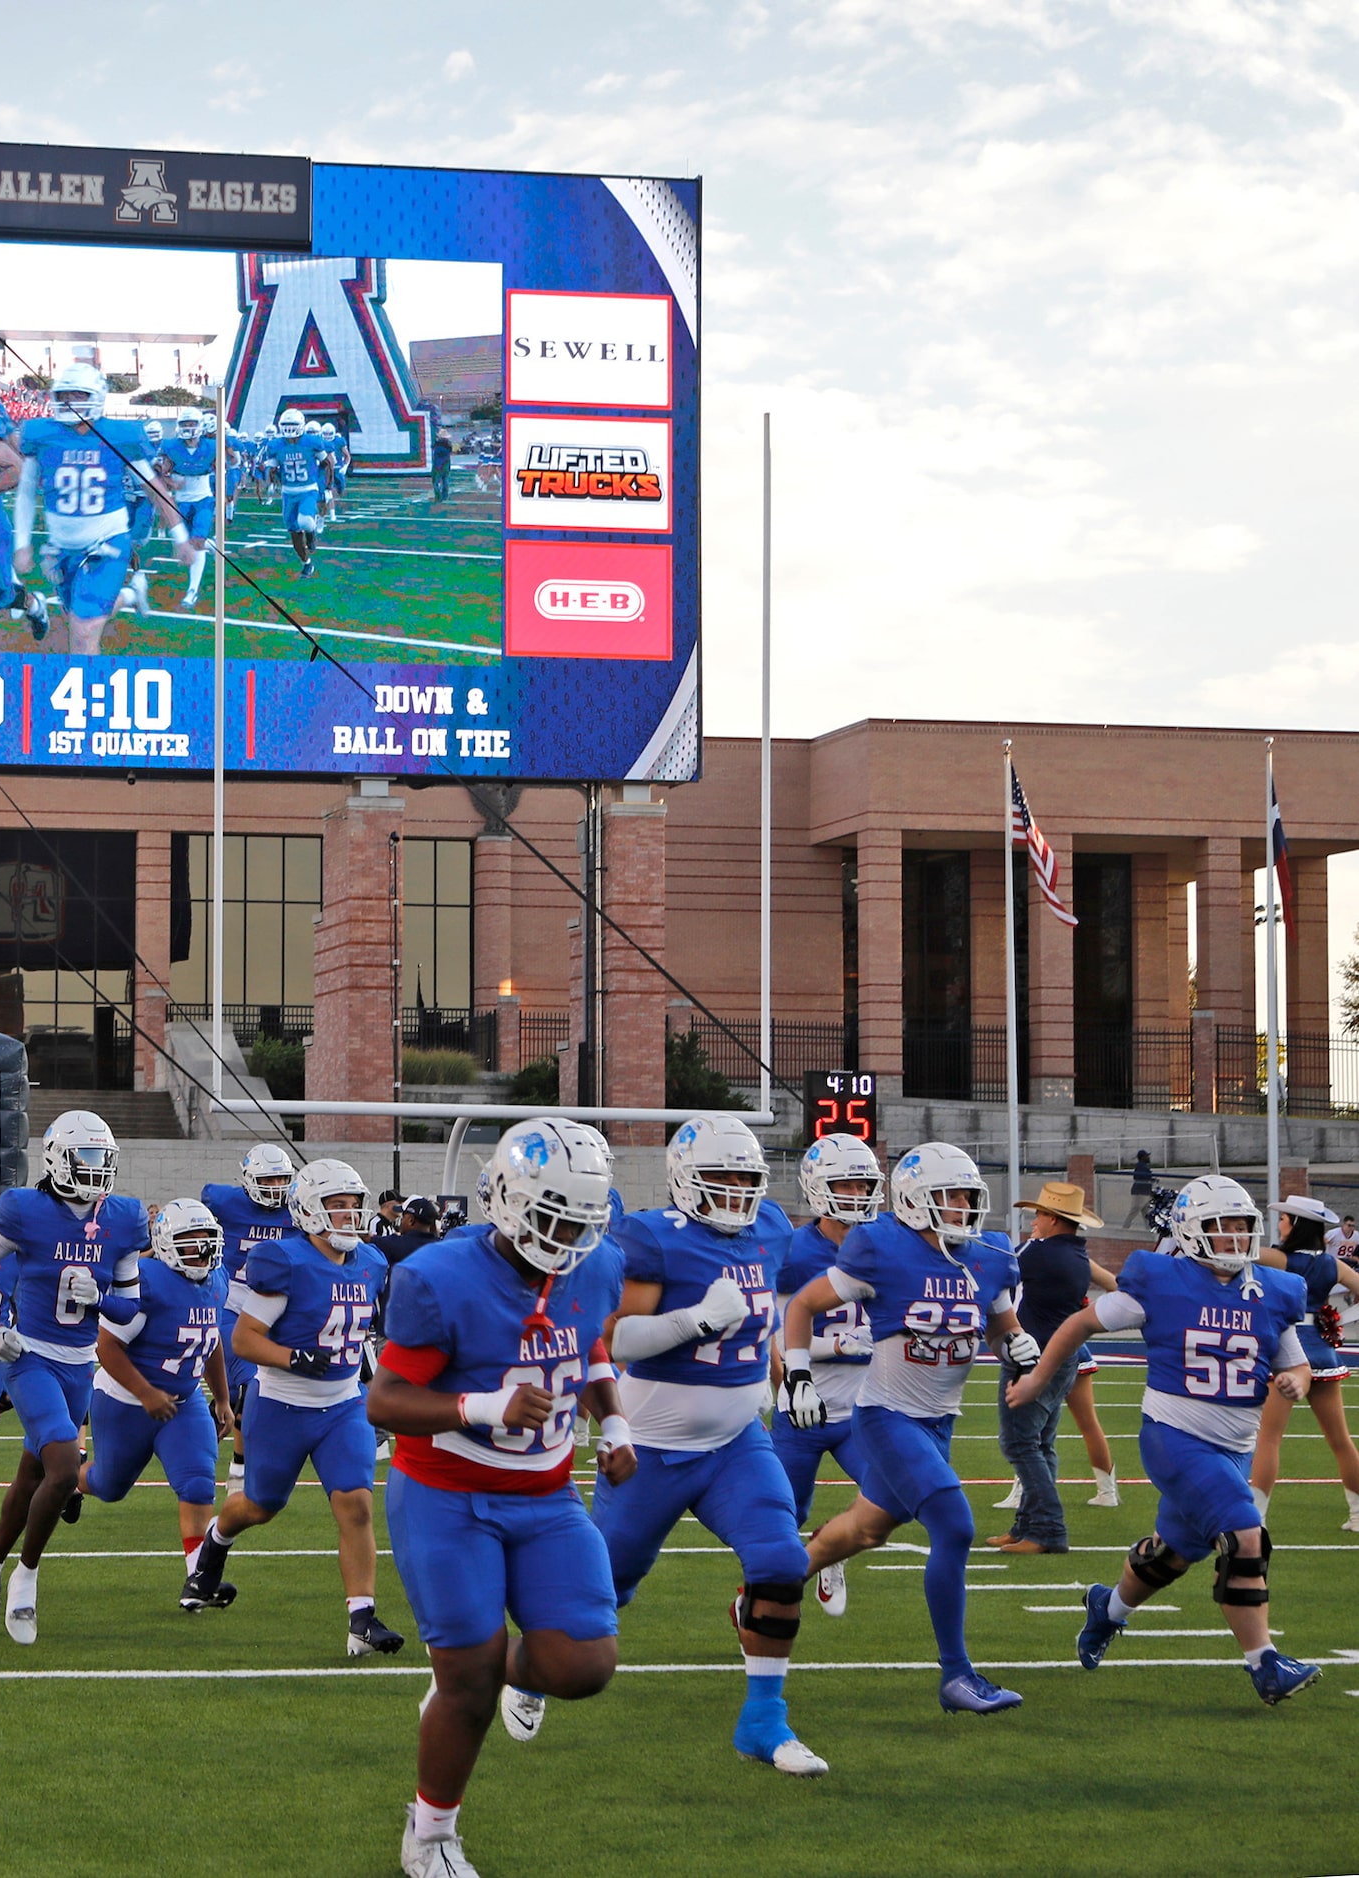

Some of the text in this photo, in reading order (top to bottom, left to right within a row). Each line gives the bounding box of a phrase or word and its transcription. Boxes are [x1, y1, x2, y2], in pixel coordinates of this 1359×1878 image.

[187, 180, 297, 214] EAGLES
[514, 336, 665, 363] SEWELL
[283, 459, 308, 482] 55
[528, 445, 647, 474] LIFTED
[517, 470, 662, 500] TRUCKS
[49, 666, 171, 731] 4:10
[375, 685, 488, 715] DOWN &
[48, 731, 190, 758] 1ST QUARTER
[333, 725, 510, 758] BALL ON THE
[826, 1074, 872, 1095] 4:10
[815, 1100, 869, 1141] 25
[248, 1225, 283, 1240] ALLEN
[54, 1241, 103, 1263] ALLEN
[722, 1264, 765, 1288] ALLEN
[923, 1277, 976, 1300] ALLEN
[331, 1283, 368, 1303] ALLEN
[188, 1307, 217, 1325] ALLEN
[1198, 1306, 1252, 1332] ALLEN
[318, 1304, 375, 1366] 45
[519, 1327, 578, 1361] ALLEN
[1183, 1328, 1260, 1398] 52
